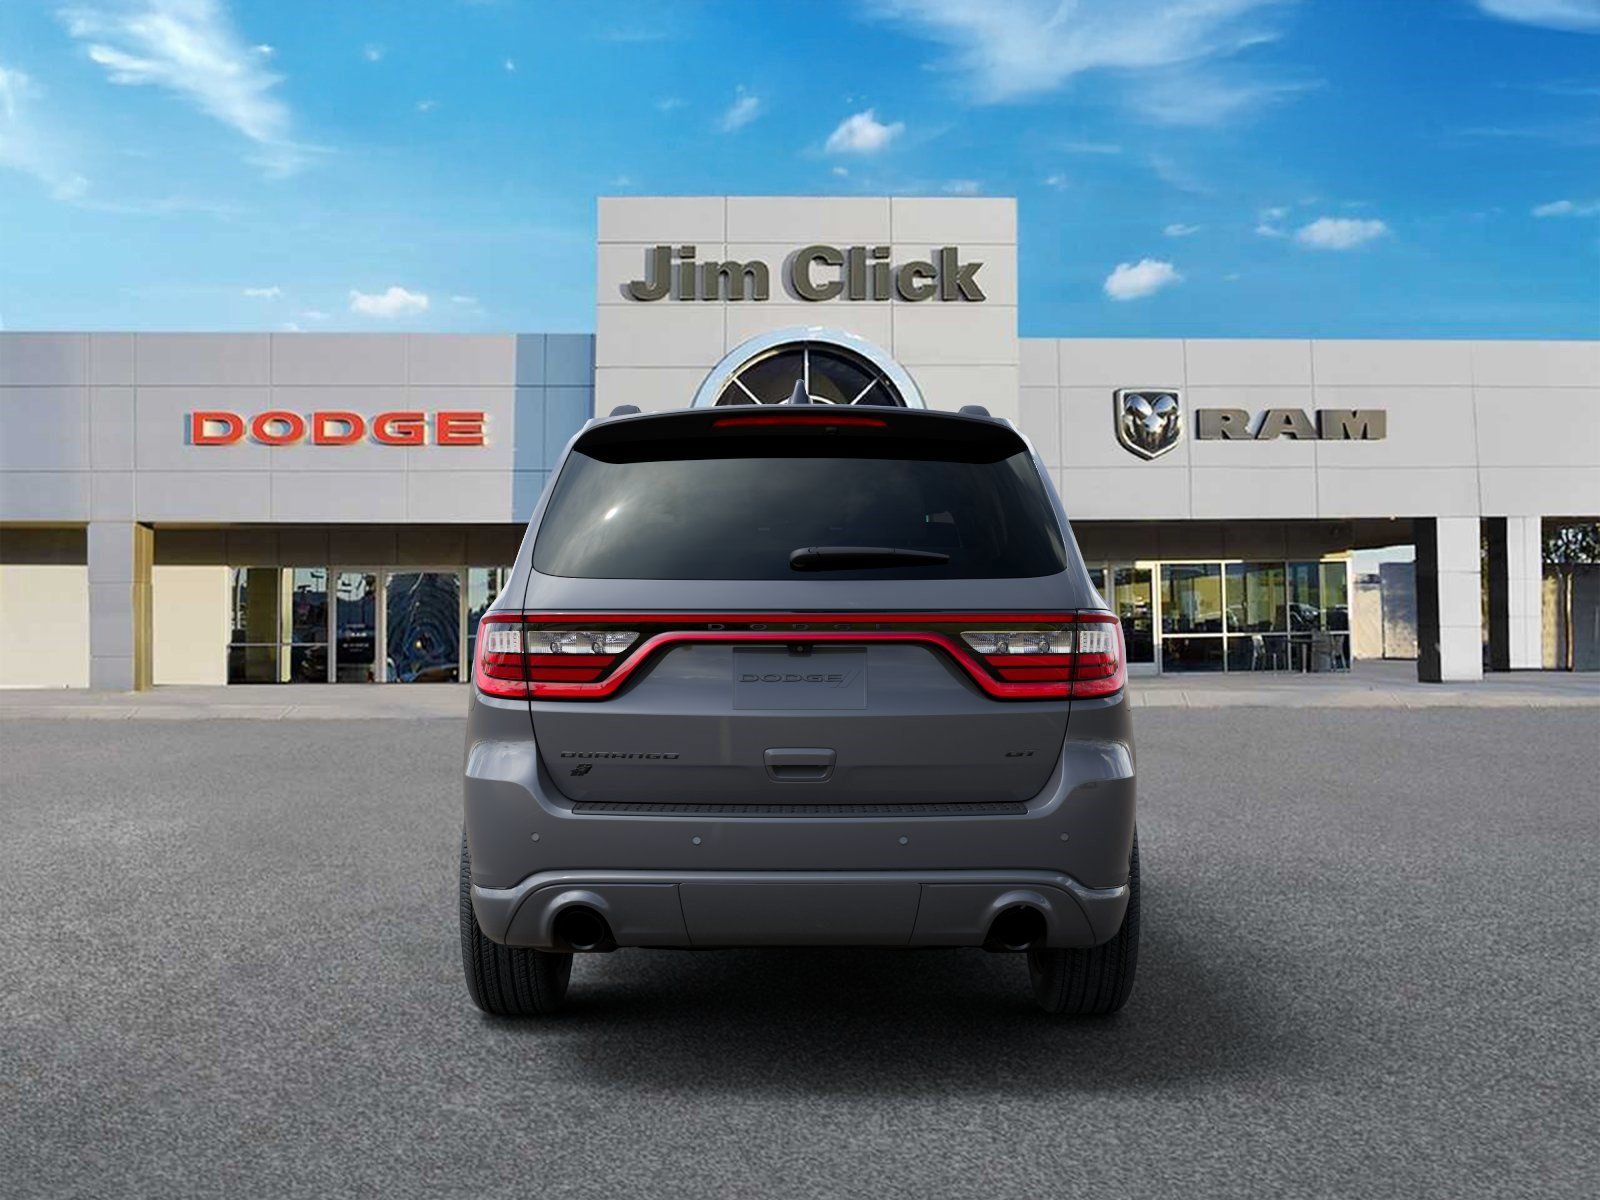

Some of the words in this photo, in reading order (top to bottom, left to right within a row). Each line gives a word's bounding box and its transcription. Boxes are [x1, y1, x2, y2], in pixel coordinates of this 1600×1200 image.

[622, 245, 770, 301] Jim
[783, 245, 986, 302] Click
[188, 410, 488, 446] DODGE
[1195, 408, 1387, 440] RAM
[738, 673, 843, 683] DODGE
[560, 751, 680, 760] DURANGO
